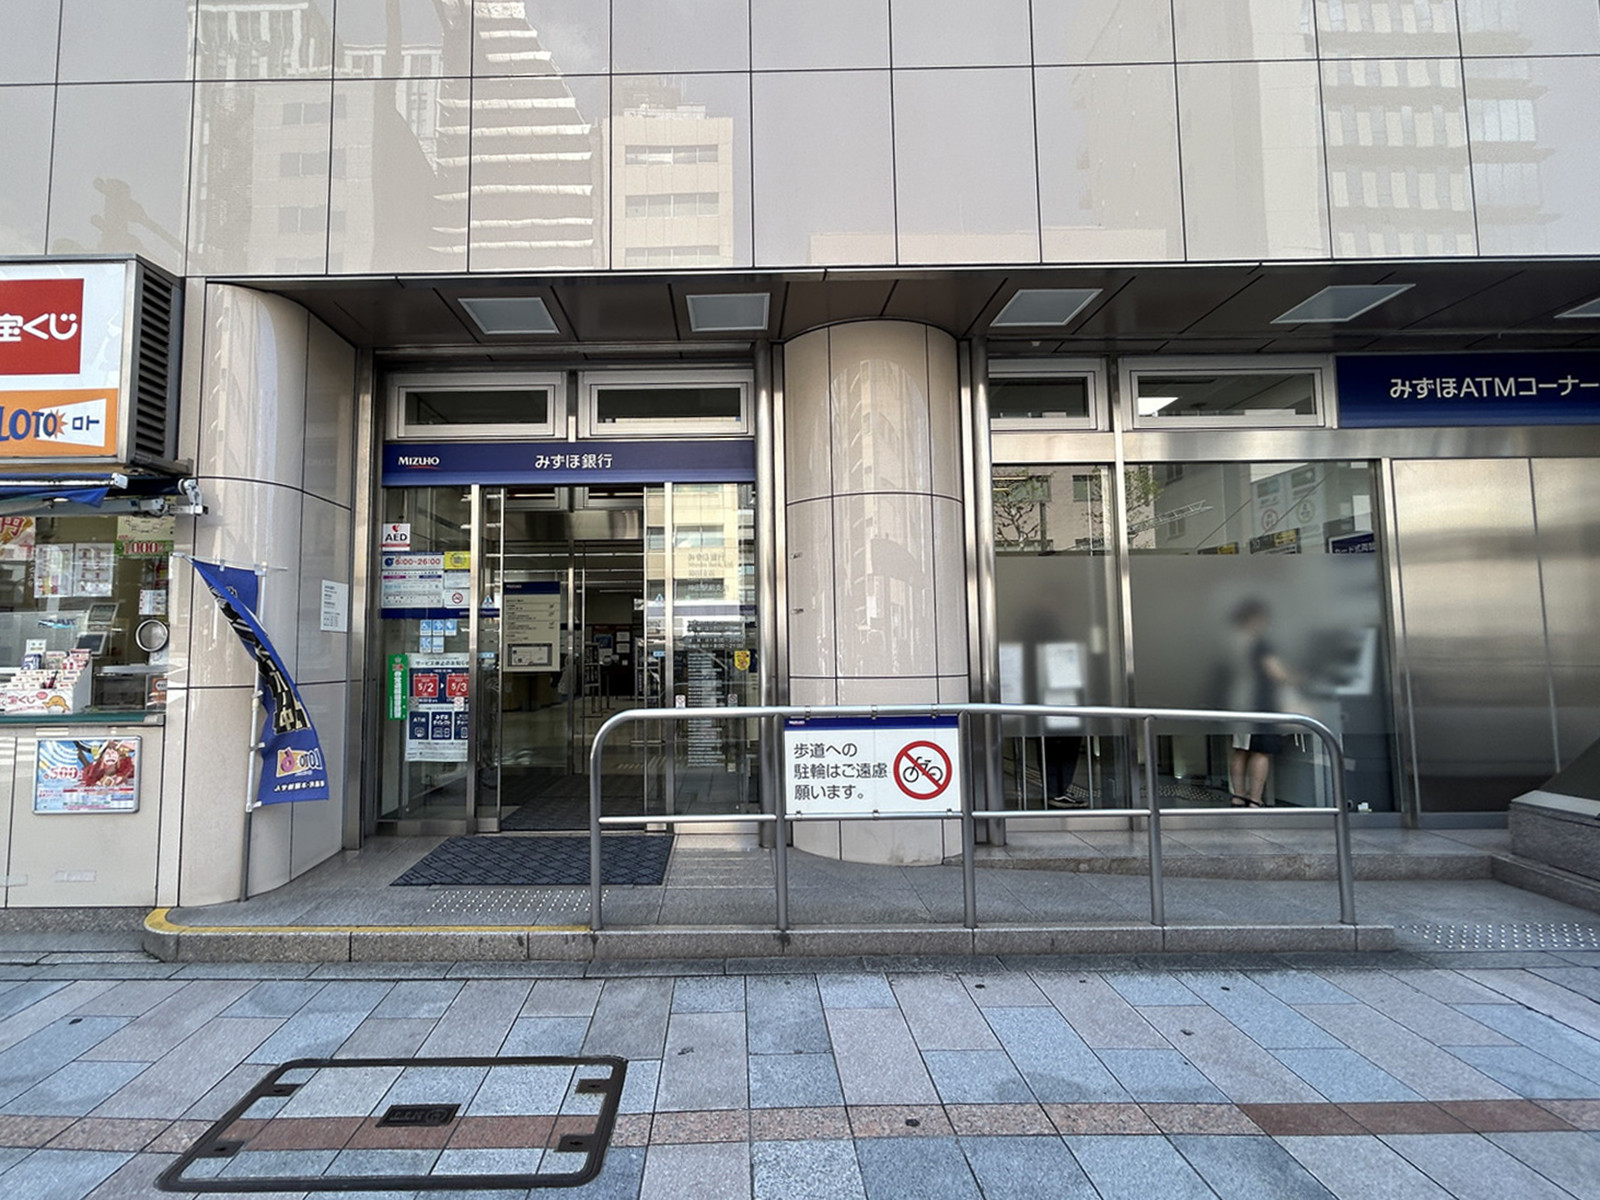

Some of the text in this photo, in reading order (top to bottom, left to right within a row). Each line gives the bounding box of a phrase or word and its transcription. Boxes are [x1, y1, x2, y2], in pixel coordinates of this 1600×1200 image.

[0, 313, 78, 342] 宝くじ
[1389, 375, 1600, 399] みずほATMコーナー
[72, 415, 100, 431] ロト
[534, 453, 613, 469] みずほ銀行
[384, 533, 408, 542] AED
[417, 682, 434, 693] 5/2
[451, 682, 468, 693] 5/3
[793, 742, 858, 759] 歩道への
[793, 762, 888, 780] 駐輪はご遠慮
[794, 784, 865, 801] 願います。
